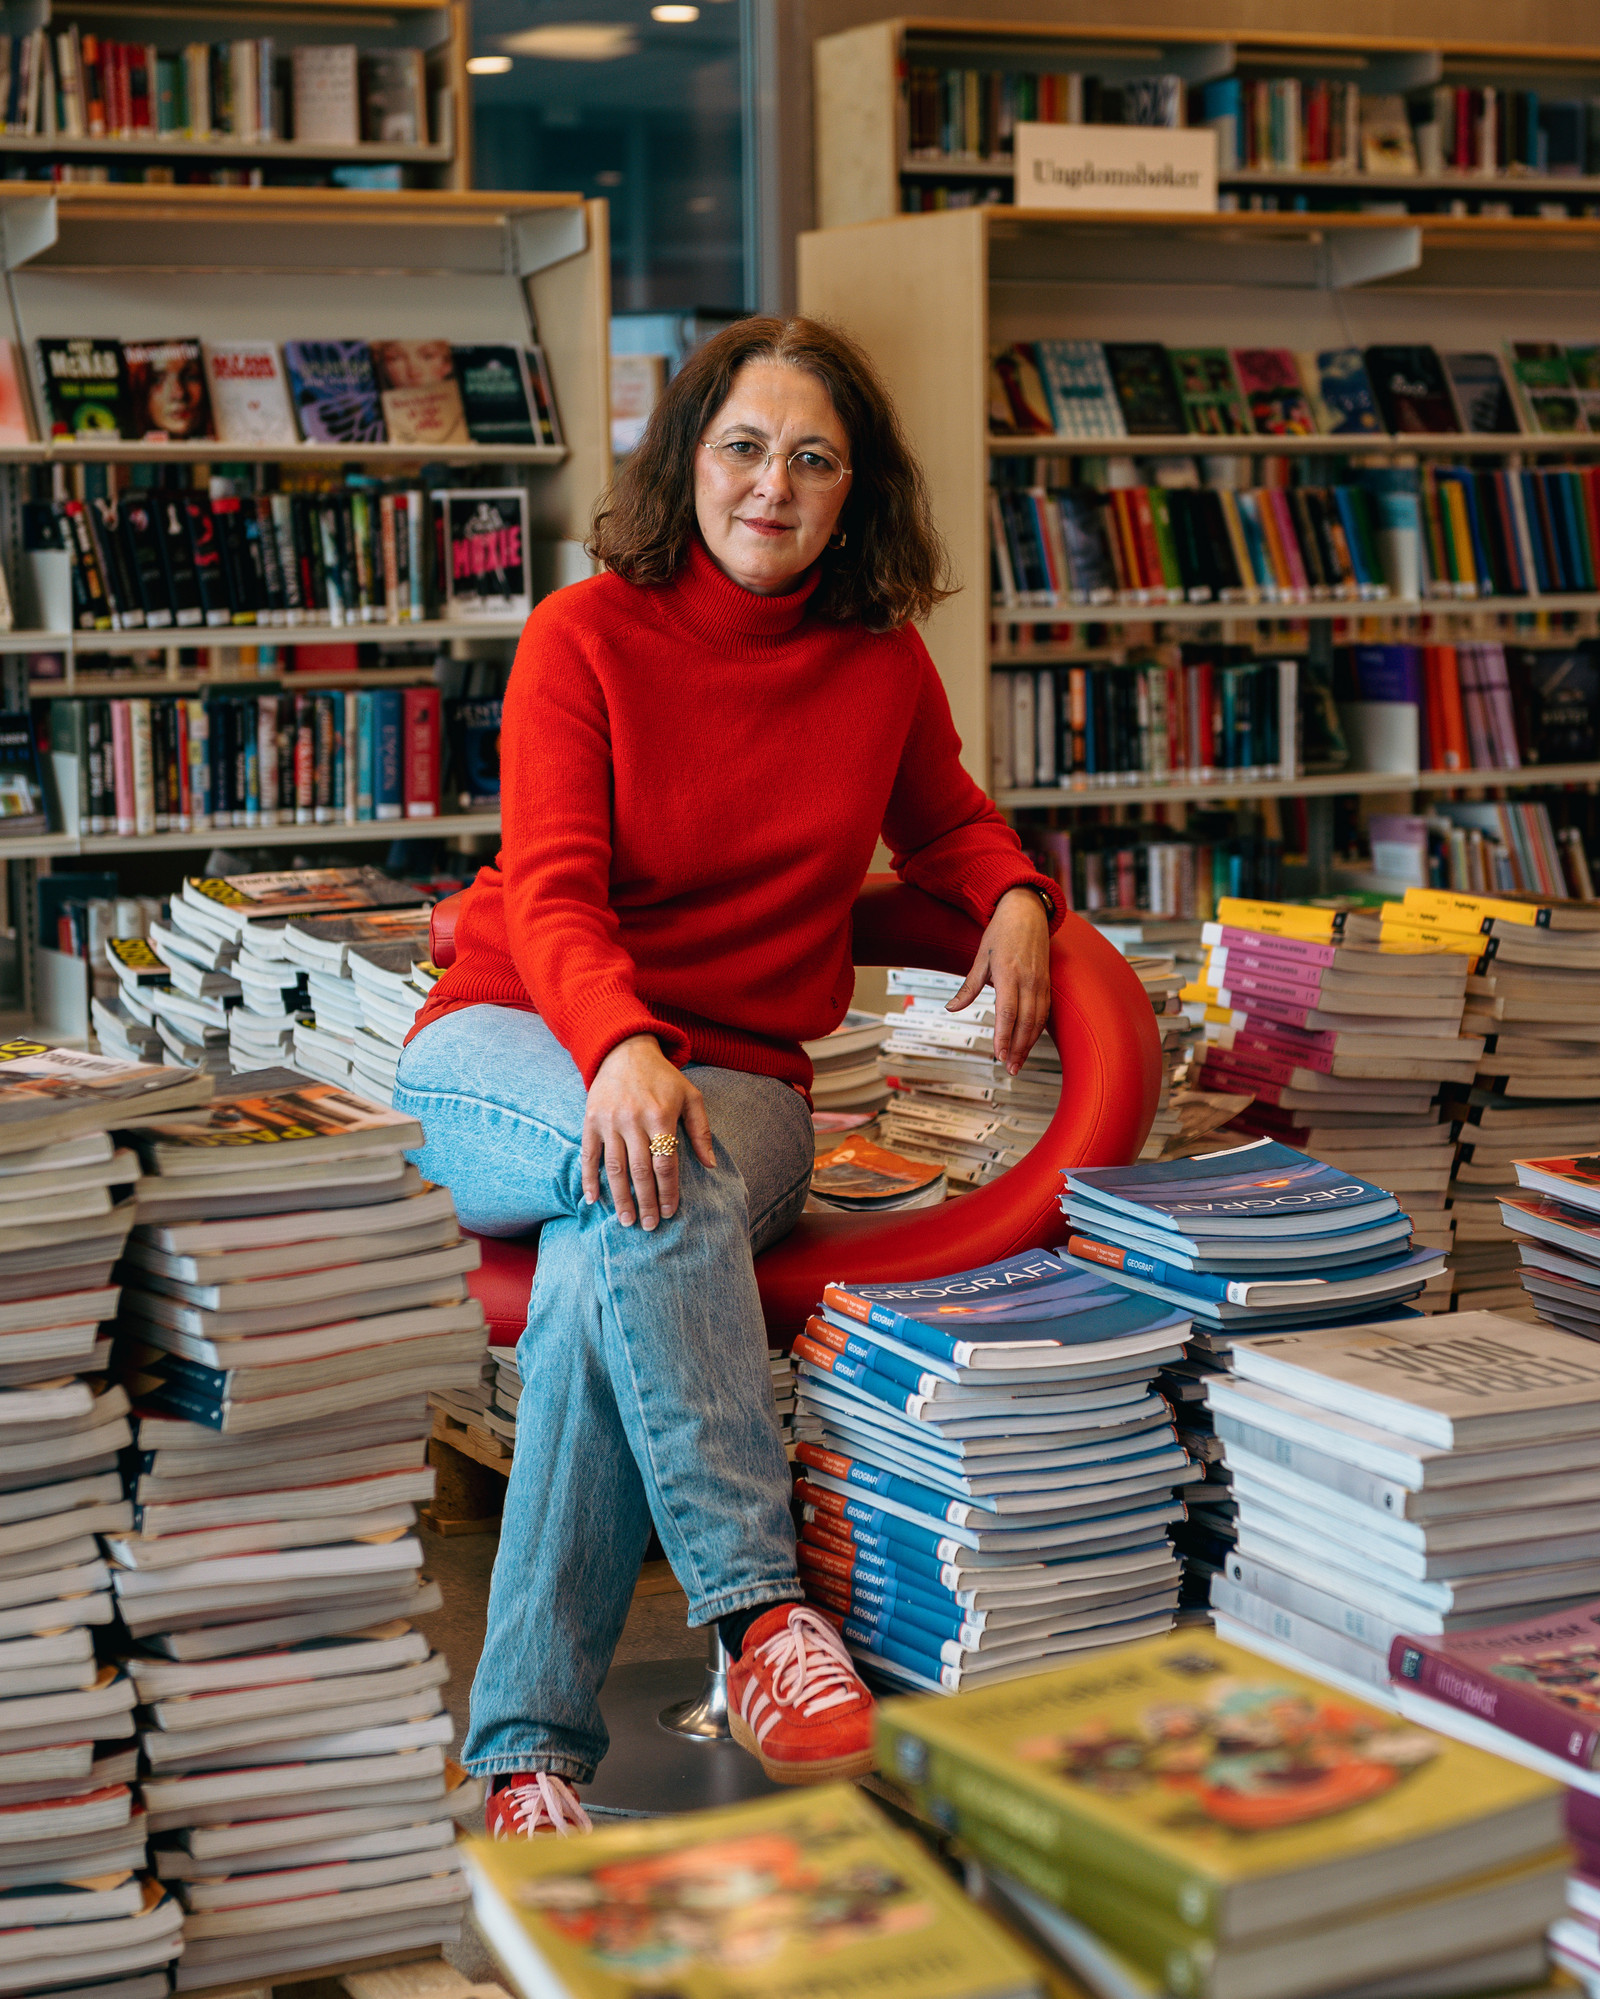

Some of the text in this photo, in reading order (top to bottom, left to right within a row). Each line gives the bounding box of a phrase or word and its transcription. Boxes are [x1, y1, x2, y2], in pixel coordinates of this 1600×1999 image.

[1032, 158, 1200, 190] Ungdomsbøker
[452, 525, 523, 579] MOXIE
[1154, 1184, 1366, 1213] GEOGRAFI
[1126, 1258, 1154, 1273] GEOGRAFI
[859, 1259, 1063, 1300] GEOGRAFI
[871, 1311, 894, 1328] GEOGRAFI
[847, 1342, 868, 1359] GEOGRAFI
[835, 1361, 856, 1378] GEOGRAFI
[851, 1468, 879, 1486] GEOGRAFI
[846, 1505, 873, 1523] GEOGRAFI
[853, 1529, 879, 1548] GEOGRAFI
[859, 1549, 886, 1567] GEOGRAFI
[854, 1568, 885, 1587] GEOGRAFI
[854, 1587, 883, 1605] GEOGRAFI
[853, 1605, 879, 1624] GEOGRAFI
[845, 1626, 872, 1646] GEOGRAFI
